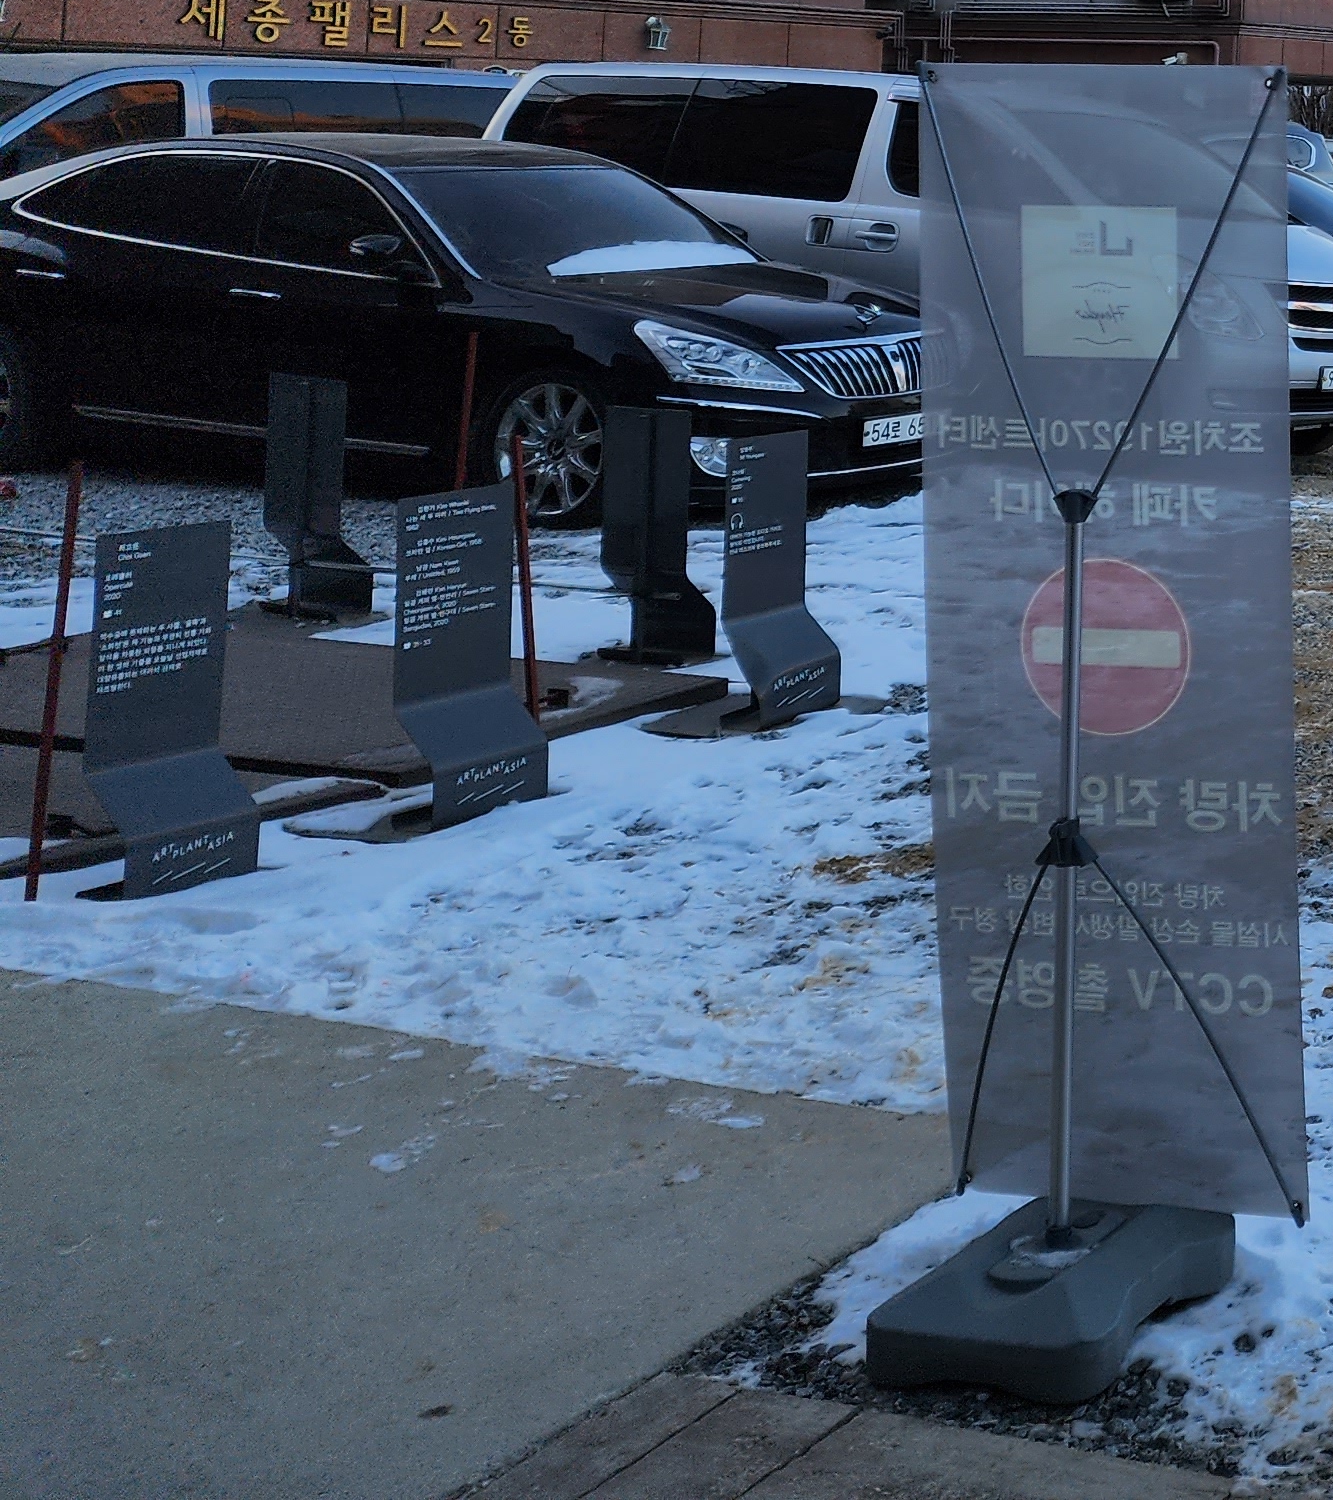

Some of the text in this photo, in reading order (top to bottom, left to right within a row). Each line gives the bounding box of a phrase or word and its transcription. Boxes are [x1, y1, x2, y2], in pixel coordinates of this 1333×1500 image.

[871, 420, 901, 443] 54로
[456, 756, 527, 786] ART PLANT ASIA
[151, 831, 234, 863] ART PLANT ASIA
